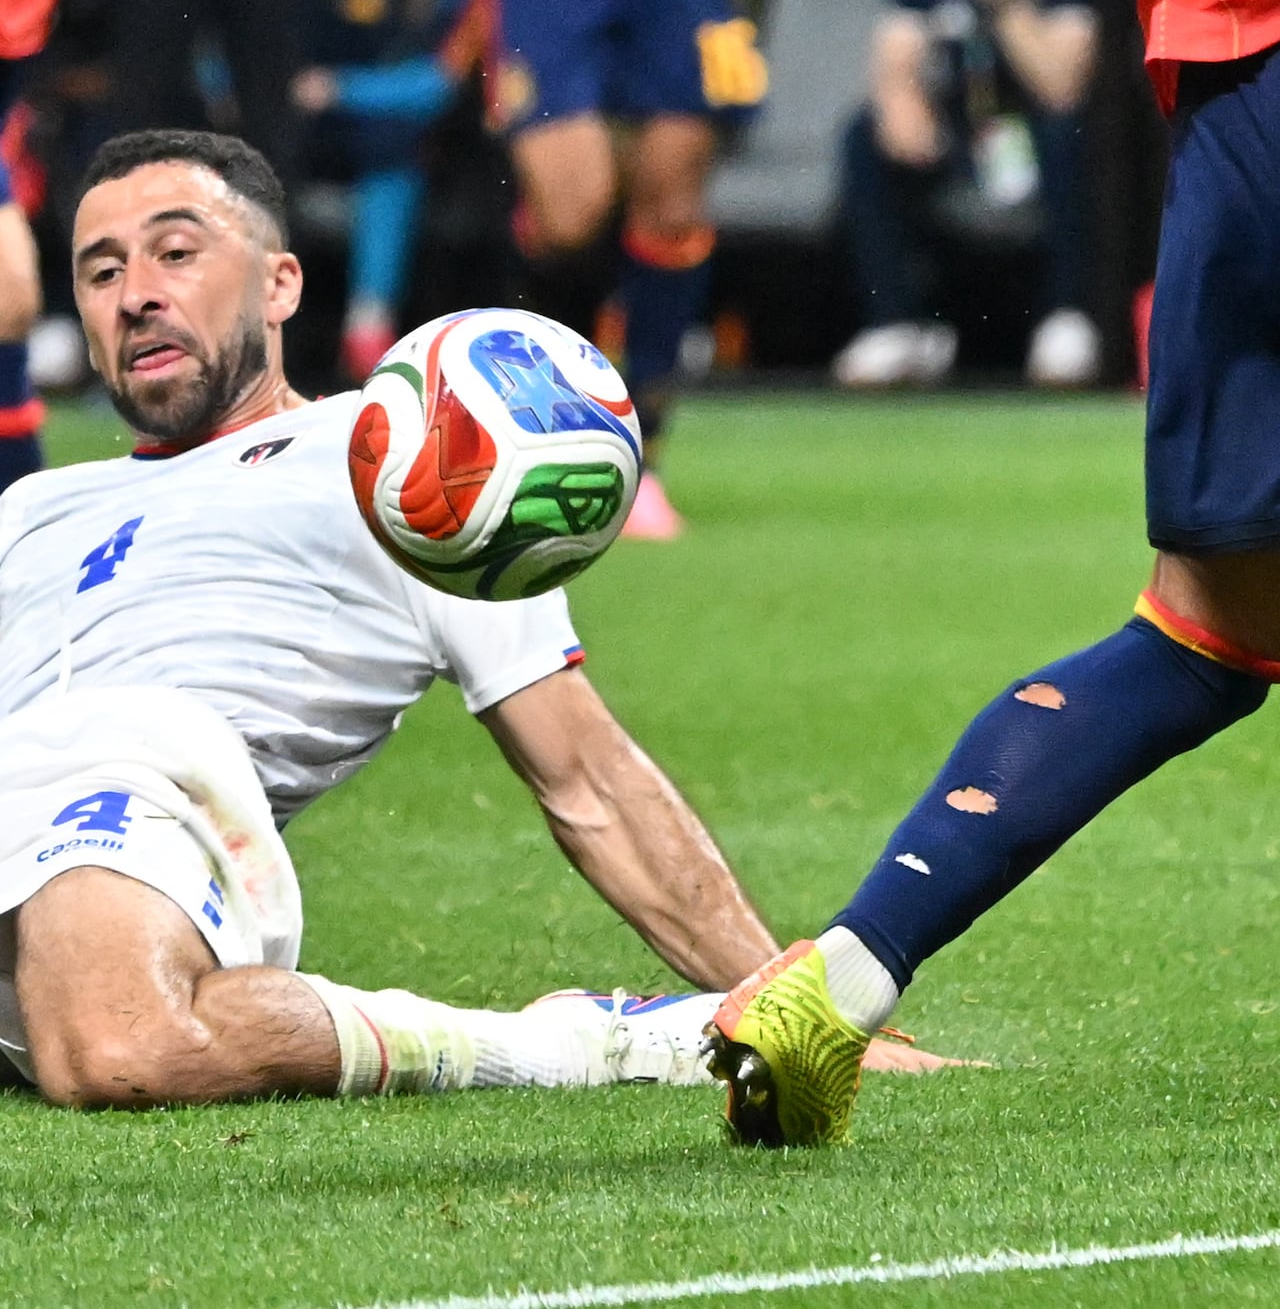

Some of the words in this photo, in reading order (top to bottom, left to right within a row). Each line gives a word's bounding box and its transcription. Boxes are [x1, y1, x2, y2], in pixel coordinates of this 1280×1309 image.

[697, 18, 769, 105] 16
[76, 514, 144, 595] 4
[51, 791, 133, 836] 4
